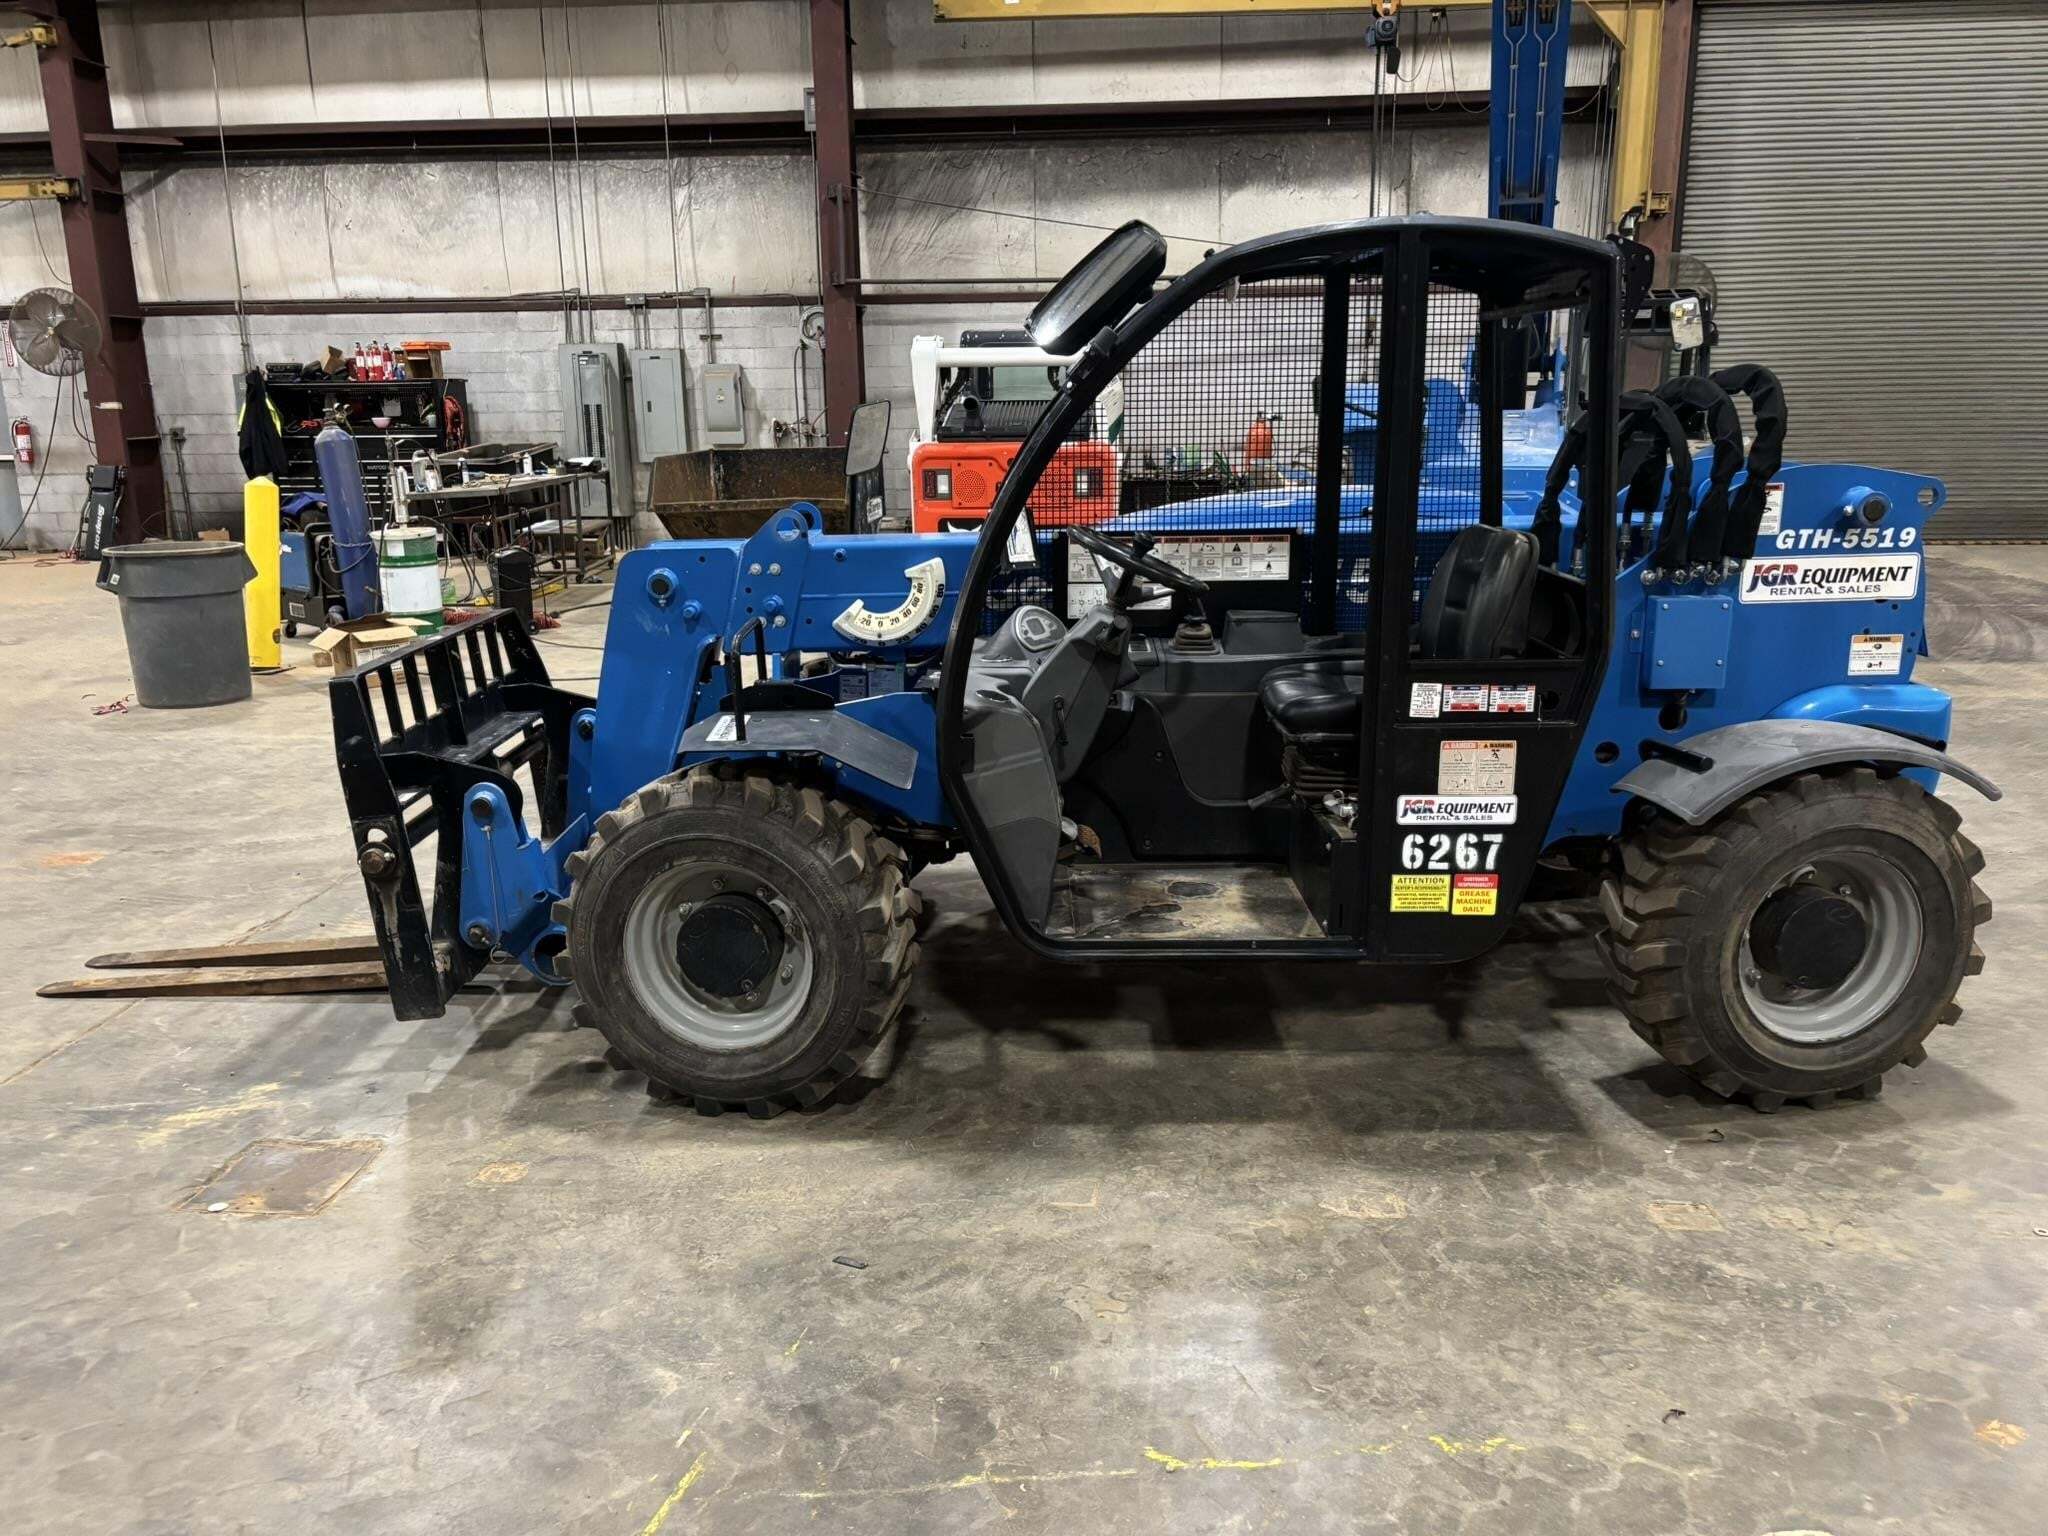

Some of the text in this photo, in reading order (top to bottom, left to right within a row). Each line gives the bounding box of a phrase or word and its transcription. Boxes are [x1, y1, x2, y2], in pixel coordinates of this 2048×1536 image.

[1776, 527, 1917, 550] GTH-5519
[1746, 564, 1912, 593] JGR EQUIPMENT
[1770, 583, 1881, 596] RENTAL & SALES
[937, 584, 945, 598] 80
[889, 616, 900, 626] 20
[902, 608, 912, 618] 40
[911, 596, 920, 607] 60
[916, 582, 924, 594] 80
[1400, 799, 1514, 818] JGR EQUIPMENT
[1402, 833, 1503, 870] 6267
